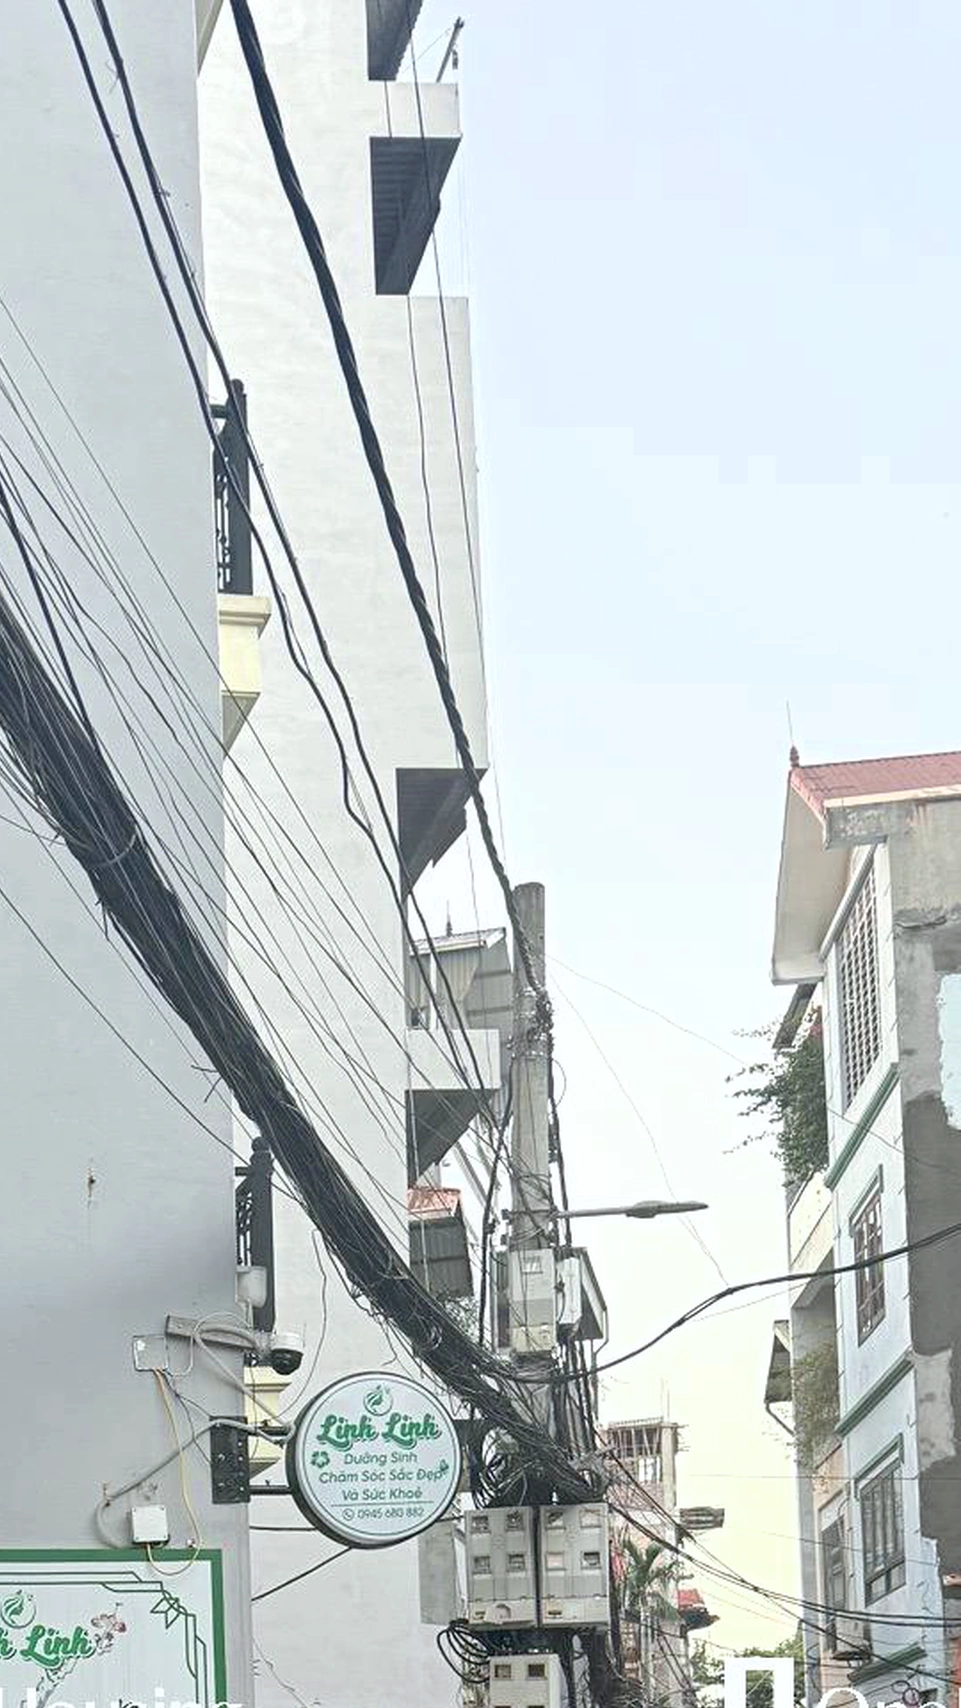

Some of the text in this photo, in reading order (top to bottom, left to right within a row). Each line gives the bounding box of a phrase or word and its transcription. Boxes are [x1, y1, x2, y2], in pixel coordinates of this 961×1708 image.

[317, 1411, 443, 1452] Linh Linh
[390, 1452, 418, 1464] Sinh
[361, 1468, 386, 1483] Sóc
[416, 1467, 443, 1483] Đẹp
[342, 1488, 359, 1501] Và
[362, 1488, 386, 1502] Sức
[19, 1624, 96, 1669] Linh
